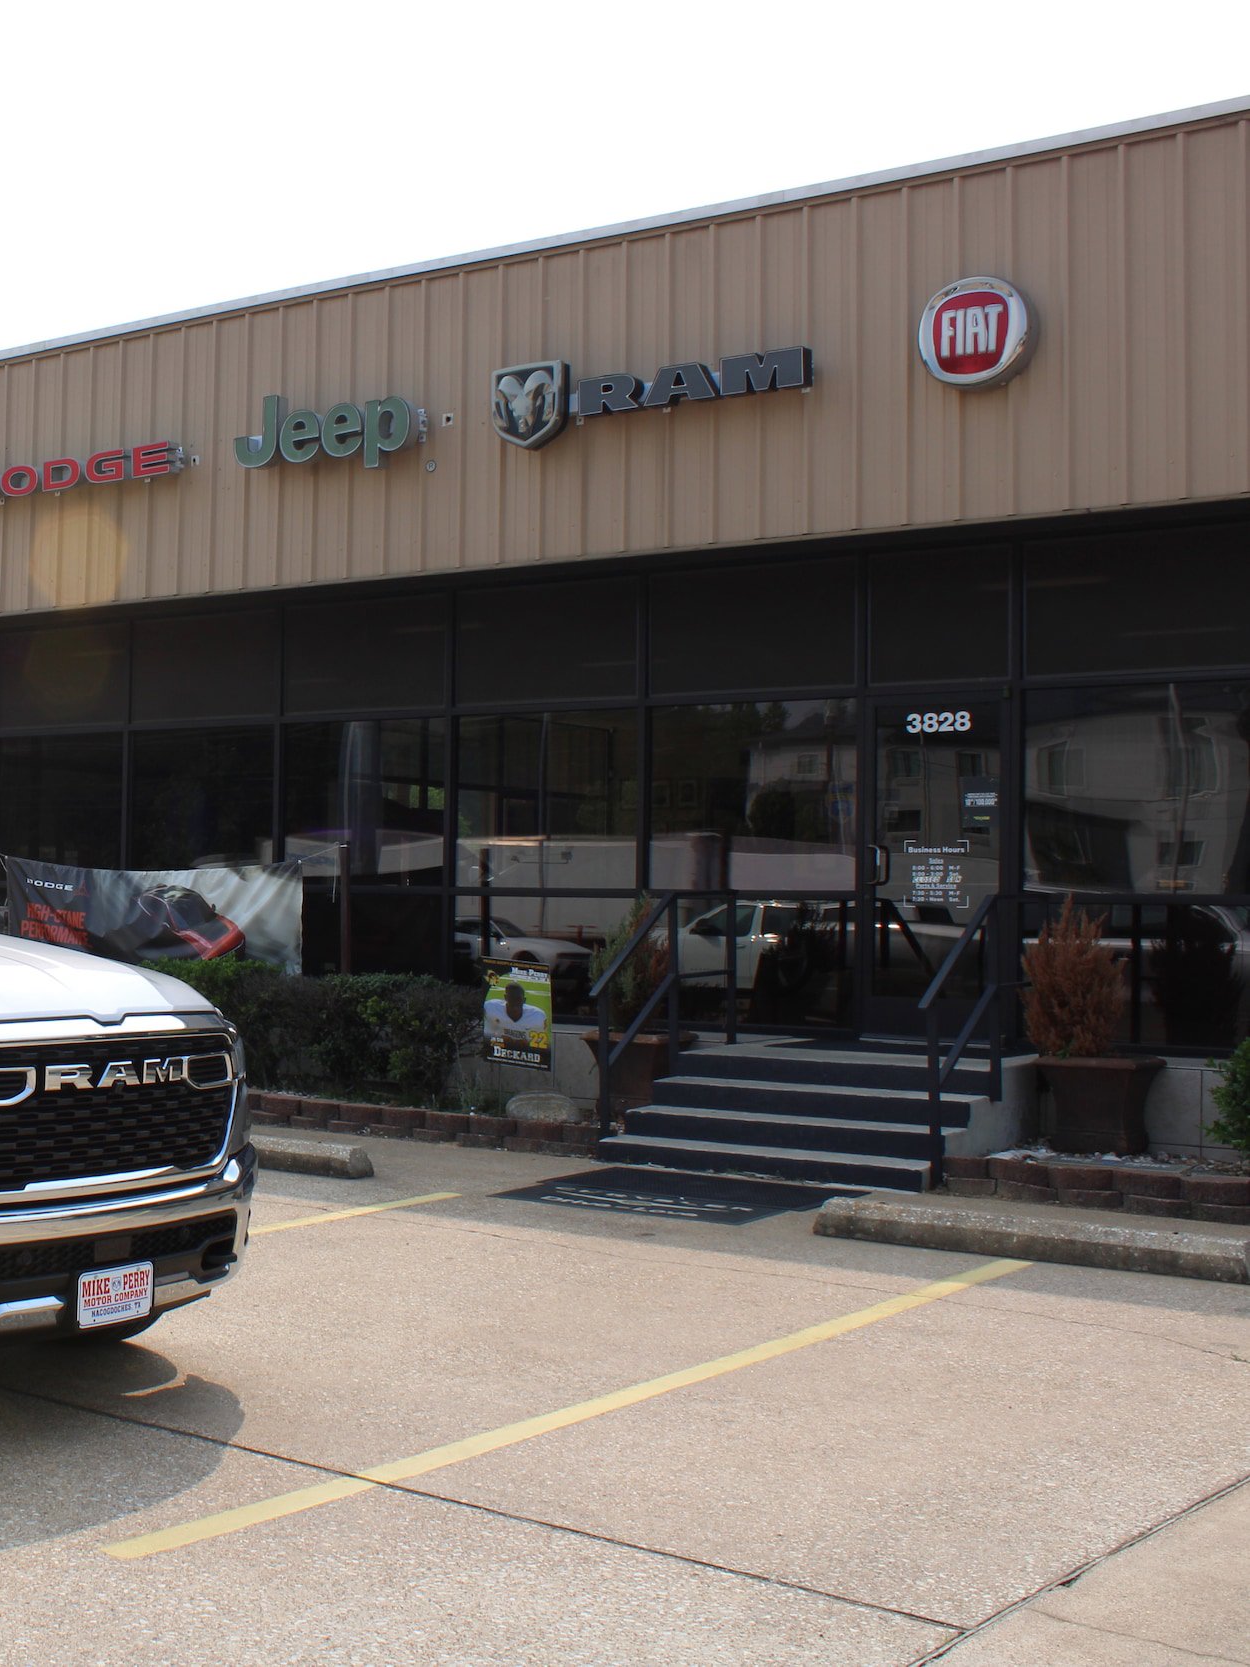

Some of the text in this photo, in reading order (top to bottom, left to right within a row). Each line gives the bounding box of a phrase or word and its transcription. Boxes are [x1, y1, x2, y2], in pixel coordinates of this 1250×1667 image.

[939, 303, 1004, 358] FIAT
[577, 345, 810, 416] RAM
[233, 394, 414, 469] Jeep
[906, 710, 971, 734] 3828
[26, 878, 74, 891] DODGE
[529, 1030, 549, 1049] 22
[493, 1045, 541, 1063] DECKARD
[44, 1055, 186, 1091] RAM
[82, 1270, 150, 1298] MIKE PERRY
[83, 1287, 148, 1308] MOTOR COMPANY
